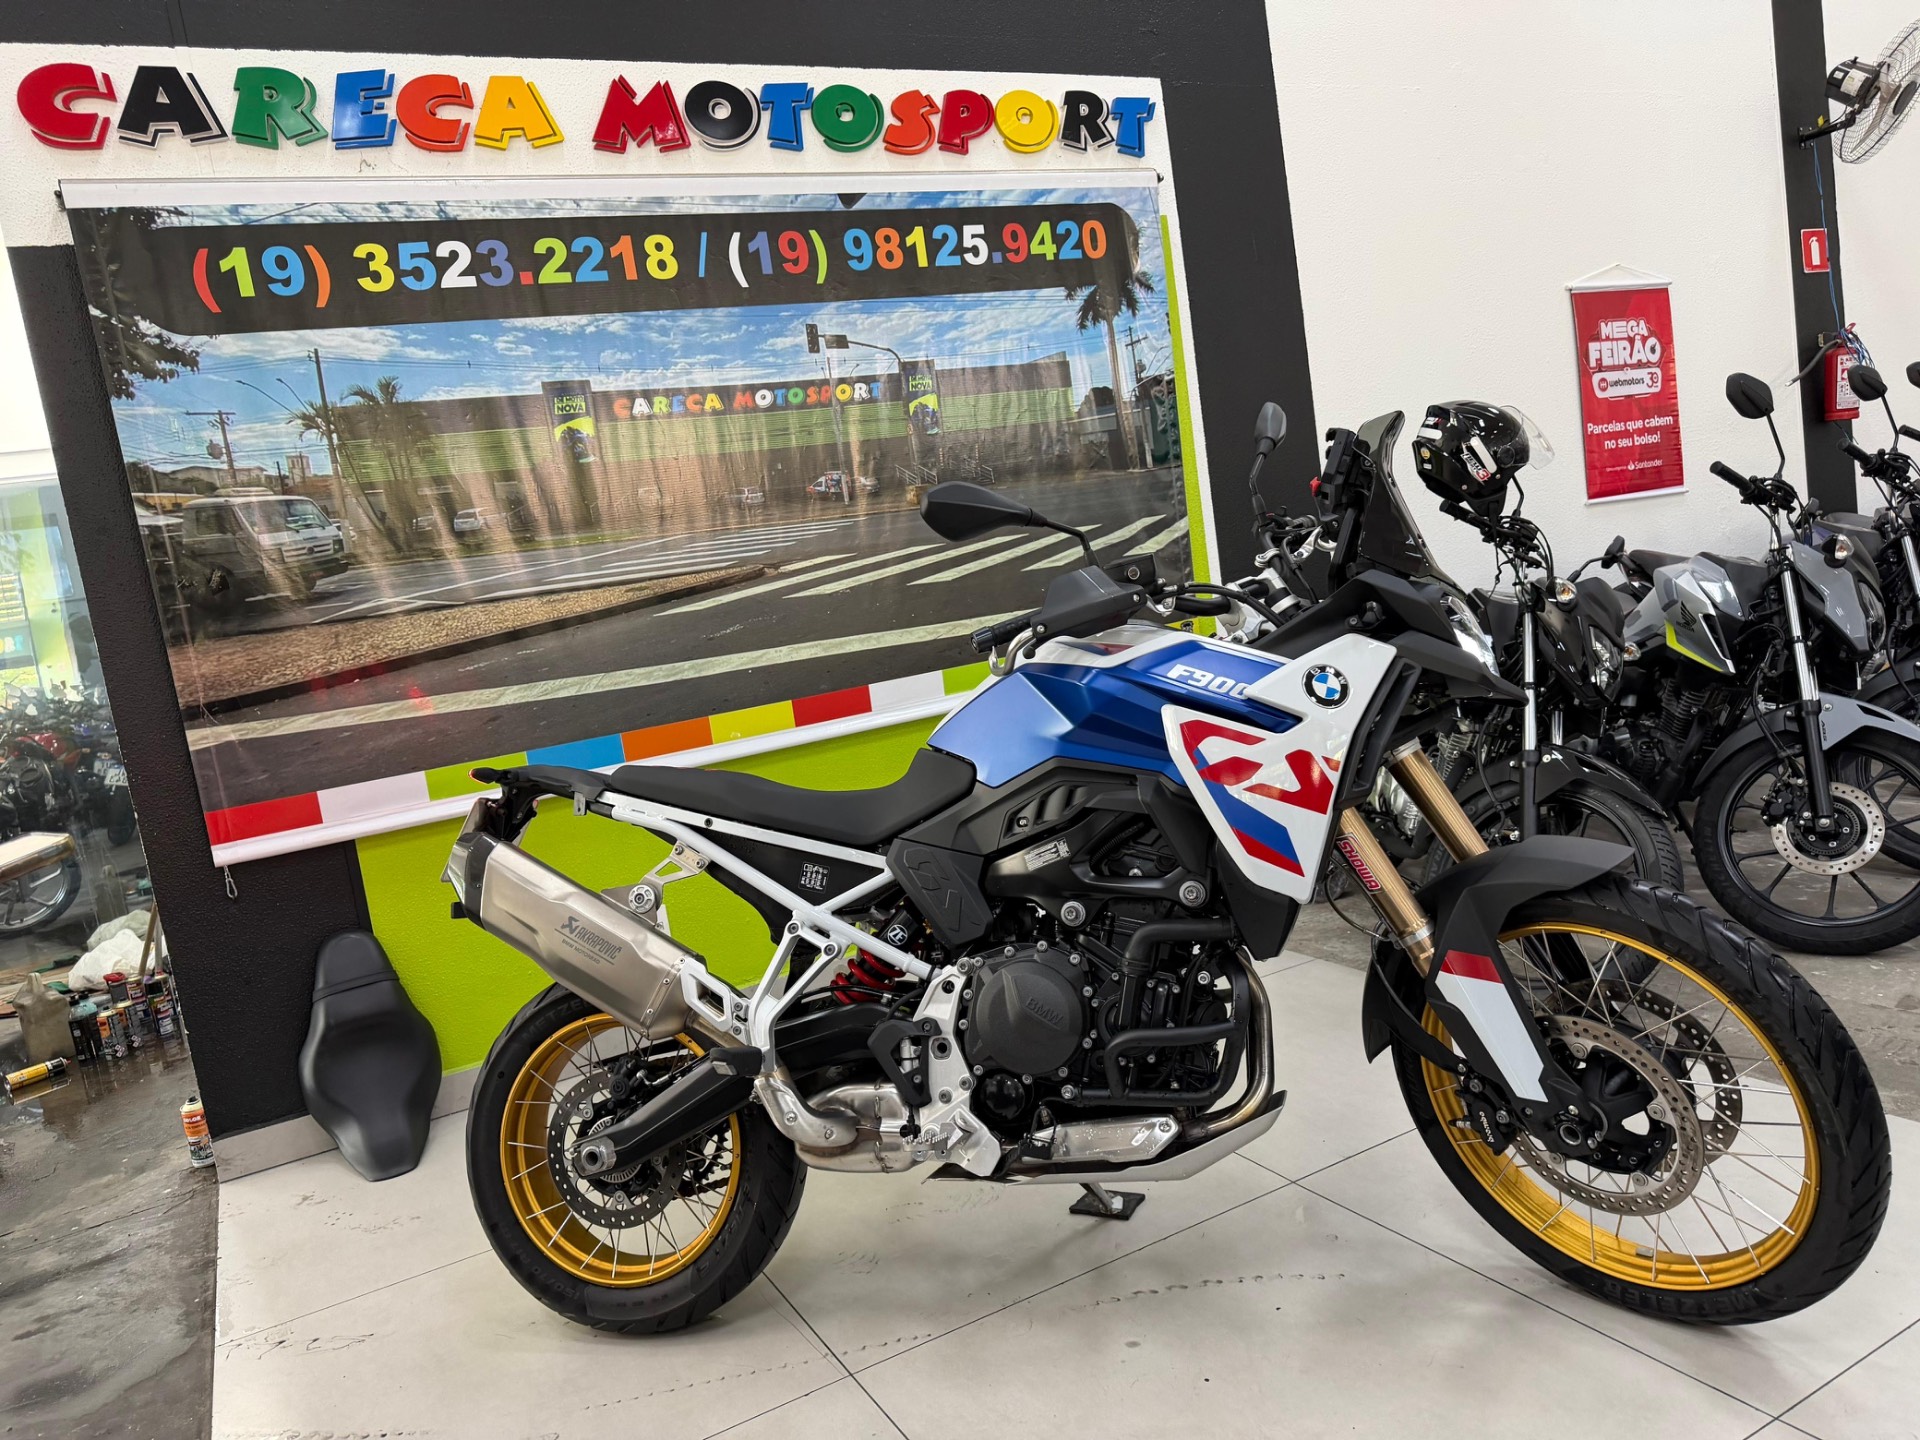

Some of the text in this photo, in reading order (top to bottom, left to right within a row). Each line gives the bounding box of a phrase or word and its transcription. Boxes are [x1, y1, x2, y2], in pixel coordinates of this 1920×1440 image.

[17, 62, 1156, 159] CARECA MOTOSPORT
[193, 244, 331, 314] (19)
[353, 234, 679, 293] 3523.2218
[728, 229, 828, 288] (19)
[843, 219, 1107, 272] 98125.9420
[1600, 320, 1649, 340] MEGA
[1588, 334, 1661, 368] FEIRÃO
[1609, 376, 1645, 388] webmotors
[556, 403, 585, 414] NOVA
[613, 382, 882, 418] CARECA MOTOSPORT
[1587, 414, 1674, 435] Parcelas que cabem
[1604, 431, 1661, 450] no seu bolso!
[1634, 459, 1663, 470] Santander
[1309, 665, 1348, 686] BMW
[1336, 836, 1382, 891] SHOWA
[1025, 996, 1064, 1027] BMW
[1478, 1110, 1495, 1143] brembo
